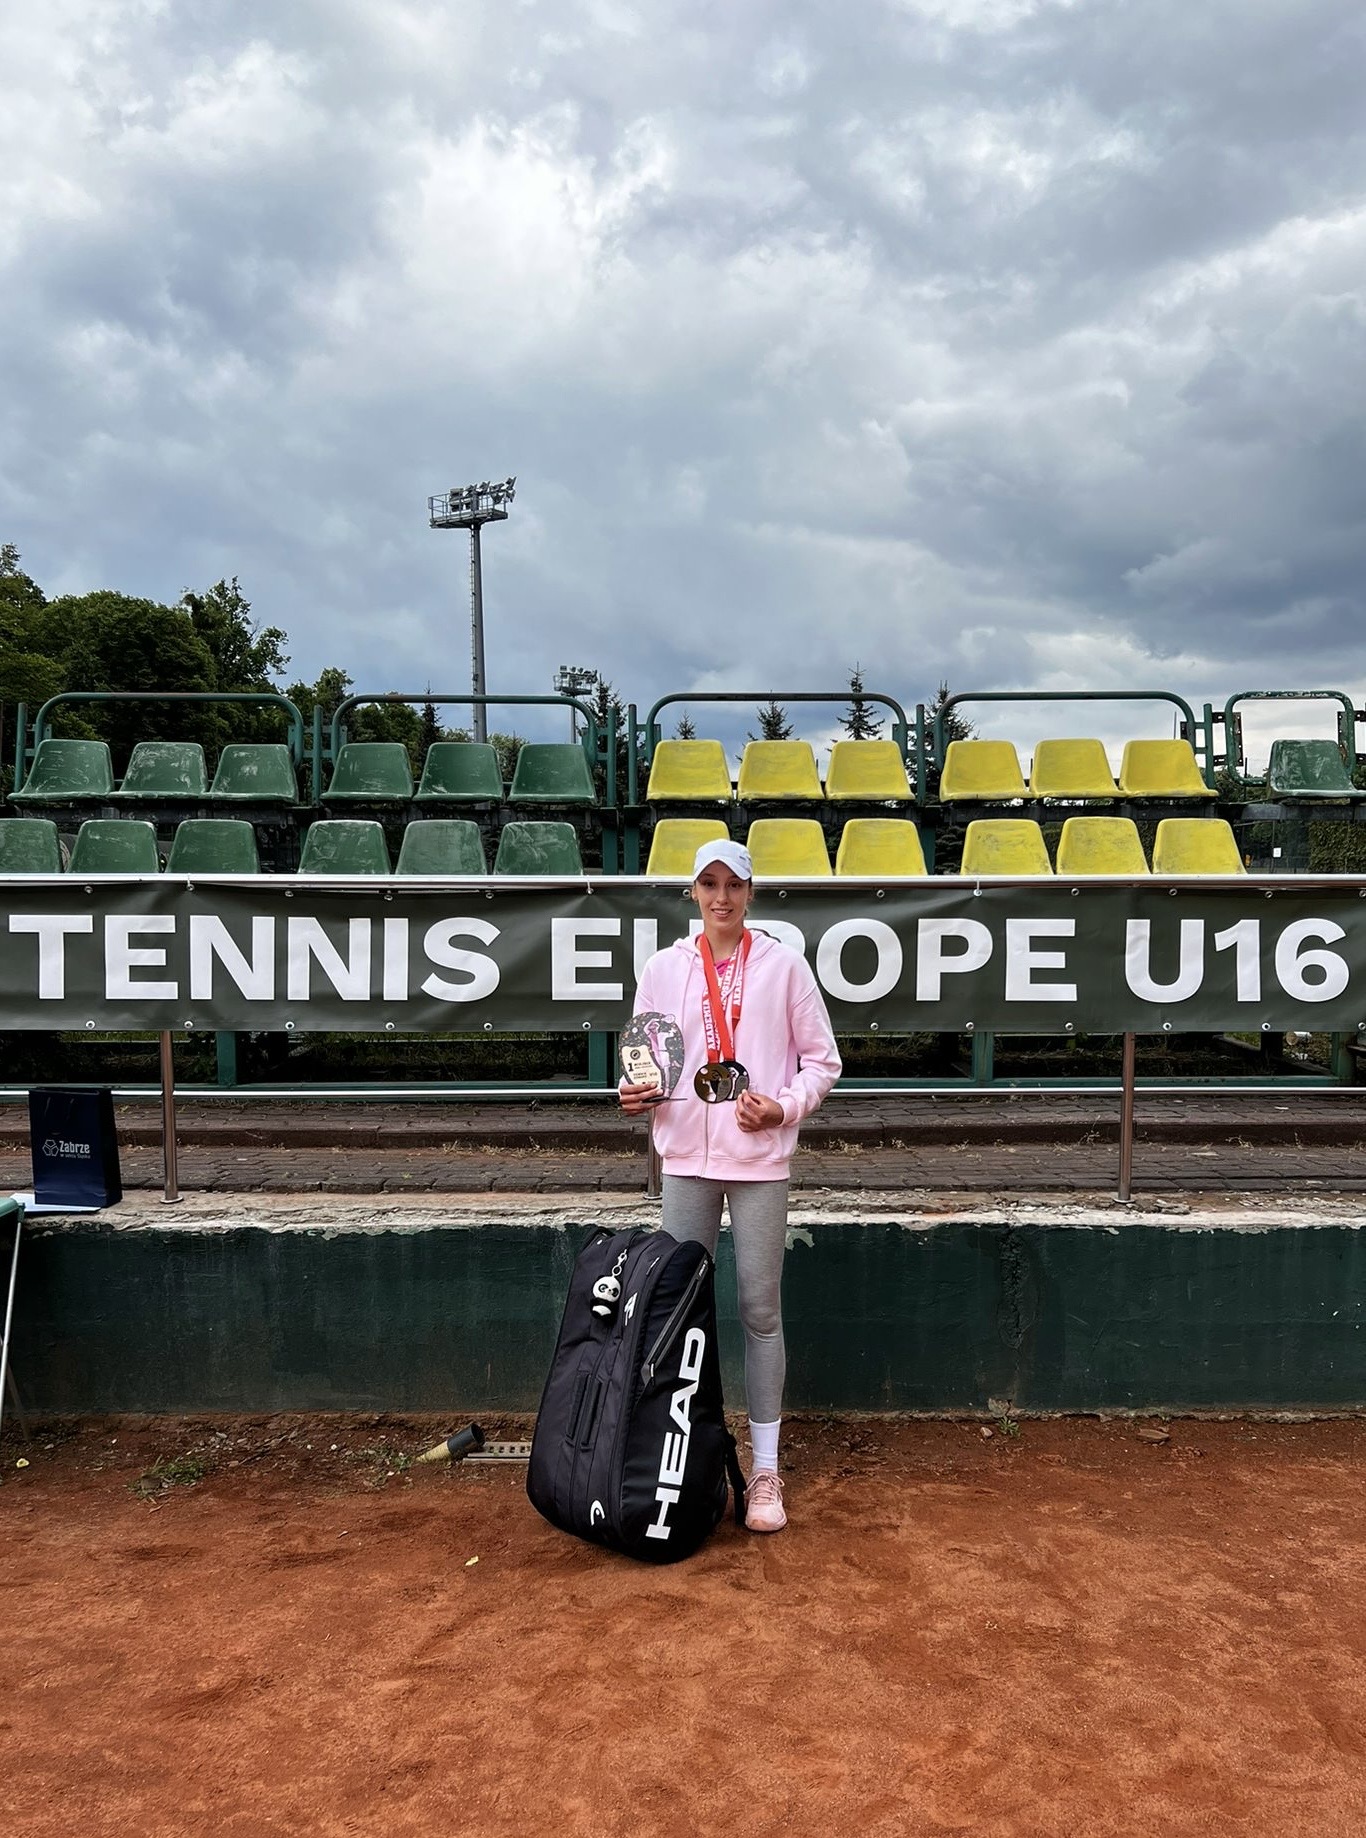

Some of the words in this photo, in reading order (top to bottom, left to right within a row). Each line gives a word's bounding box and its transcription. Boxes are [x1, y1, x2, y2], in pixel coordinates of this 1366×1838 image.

[9, 914, 501, 1003] TENNIS
[552, 916, 1077, 1003] EOPE
[1125, 917, 1350, 1003] U16
[703, 999, 716, 1050] AKADEMIA
[628, 1062, 634, 1072] 1
[59, 1140, 90, 1153] Zabrze
[645, 1327, 706, 1540] HEAD
